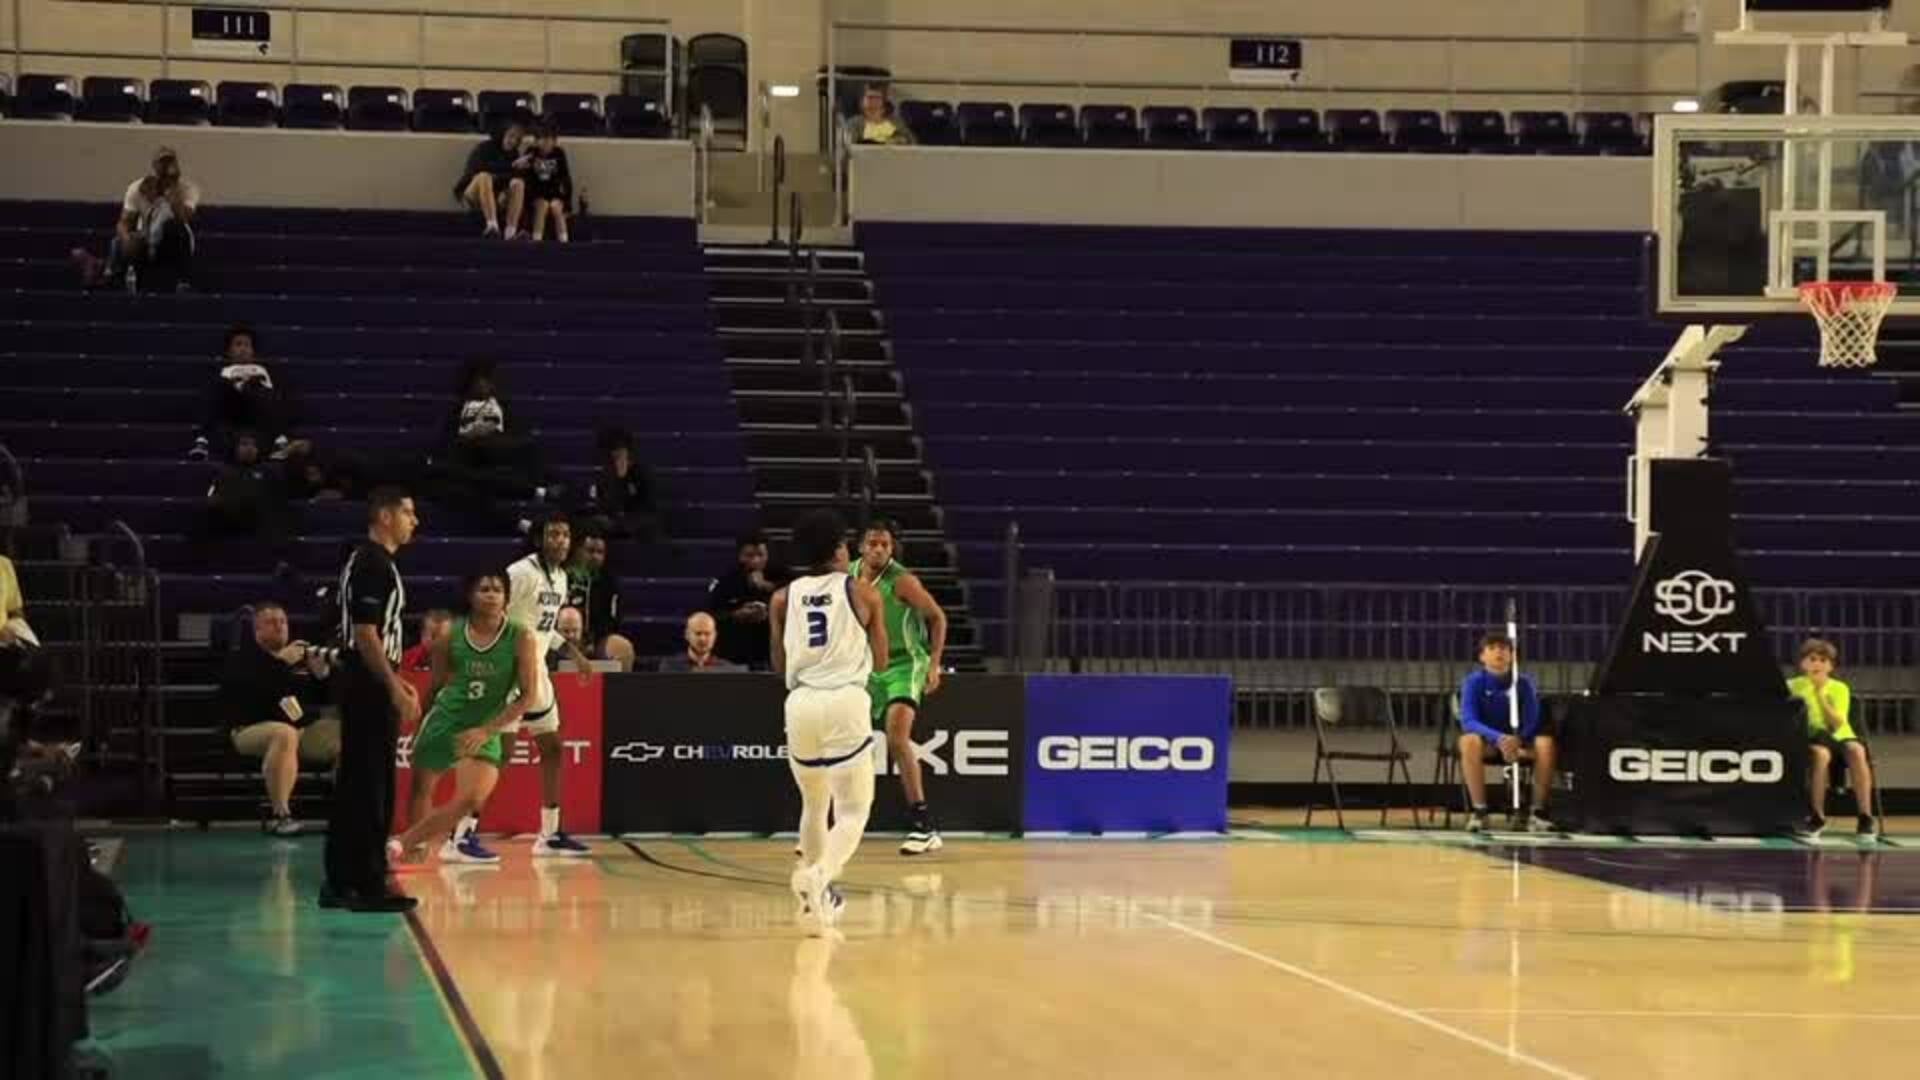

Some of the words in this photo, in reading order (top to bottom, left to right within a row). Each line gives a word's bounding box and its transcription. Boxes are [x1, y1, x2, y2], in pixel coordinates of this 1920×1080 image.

[223, 15, 255, 35] 111
[1256, 44, 1290, 65] 112
[806, 611, 829, 648] 3
[1642, 631, 1747, 653] NEXT
[468, 681, 486, 700] 3
[673, 744, 790, 760] CHEVROLE
[872, 729, 1009, 775] KE
[1037, 735, 1215, 771] GEICO
[1608, 747, 1784, 783] GEICO
